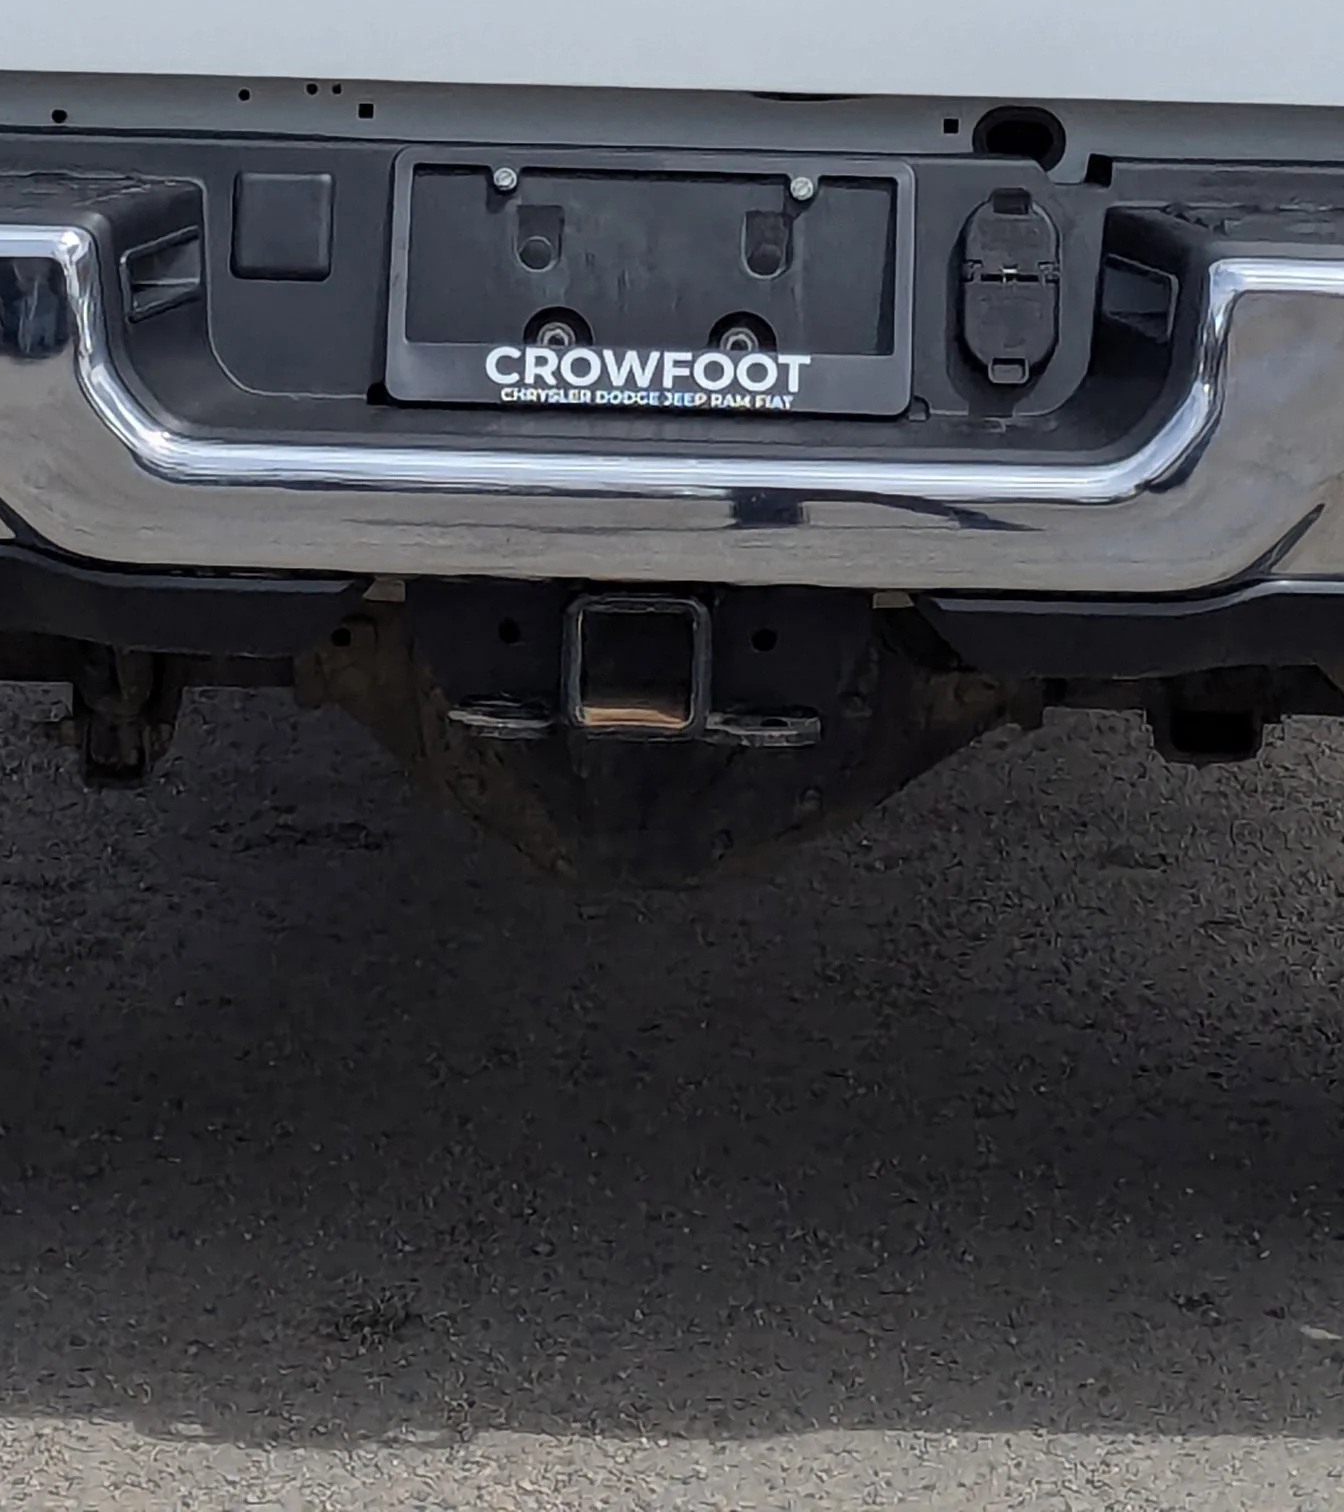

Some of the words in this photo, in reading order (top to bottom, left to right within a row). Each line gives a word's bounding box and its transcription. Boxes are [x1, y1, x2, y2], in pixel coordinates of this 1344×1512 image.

[485, 346, 811, 393] CROWFOOT
[501, 387, 592, 405] CHRYSLER
[595, 390, 660, 406] DODGE
[663, 392, 707, 407] JEEP
[711, 393, 752, 409] RAM
[756, 394, 794, 410] FIAT
